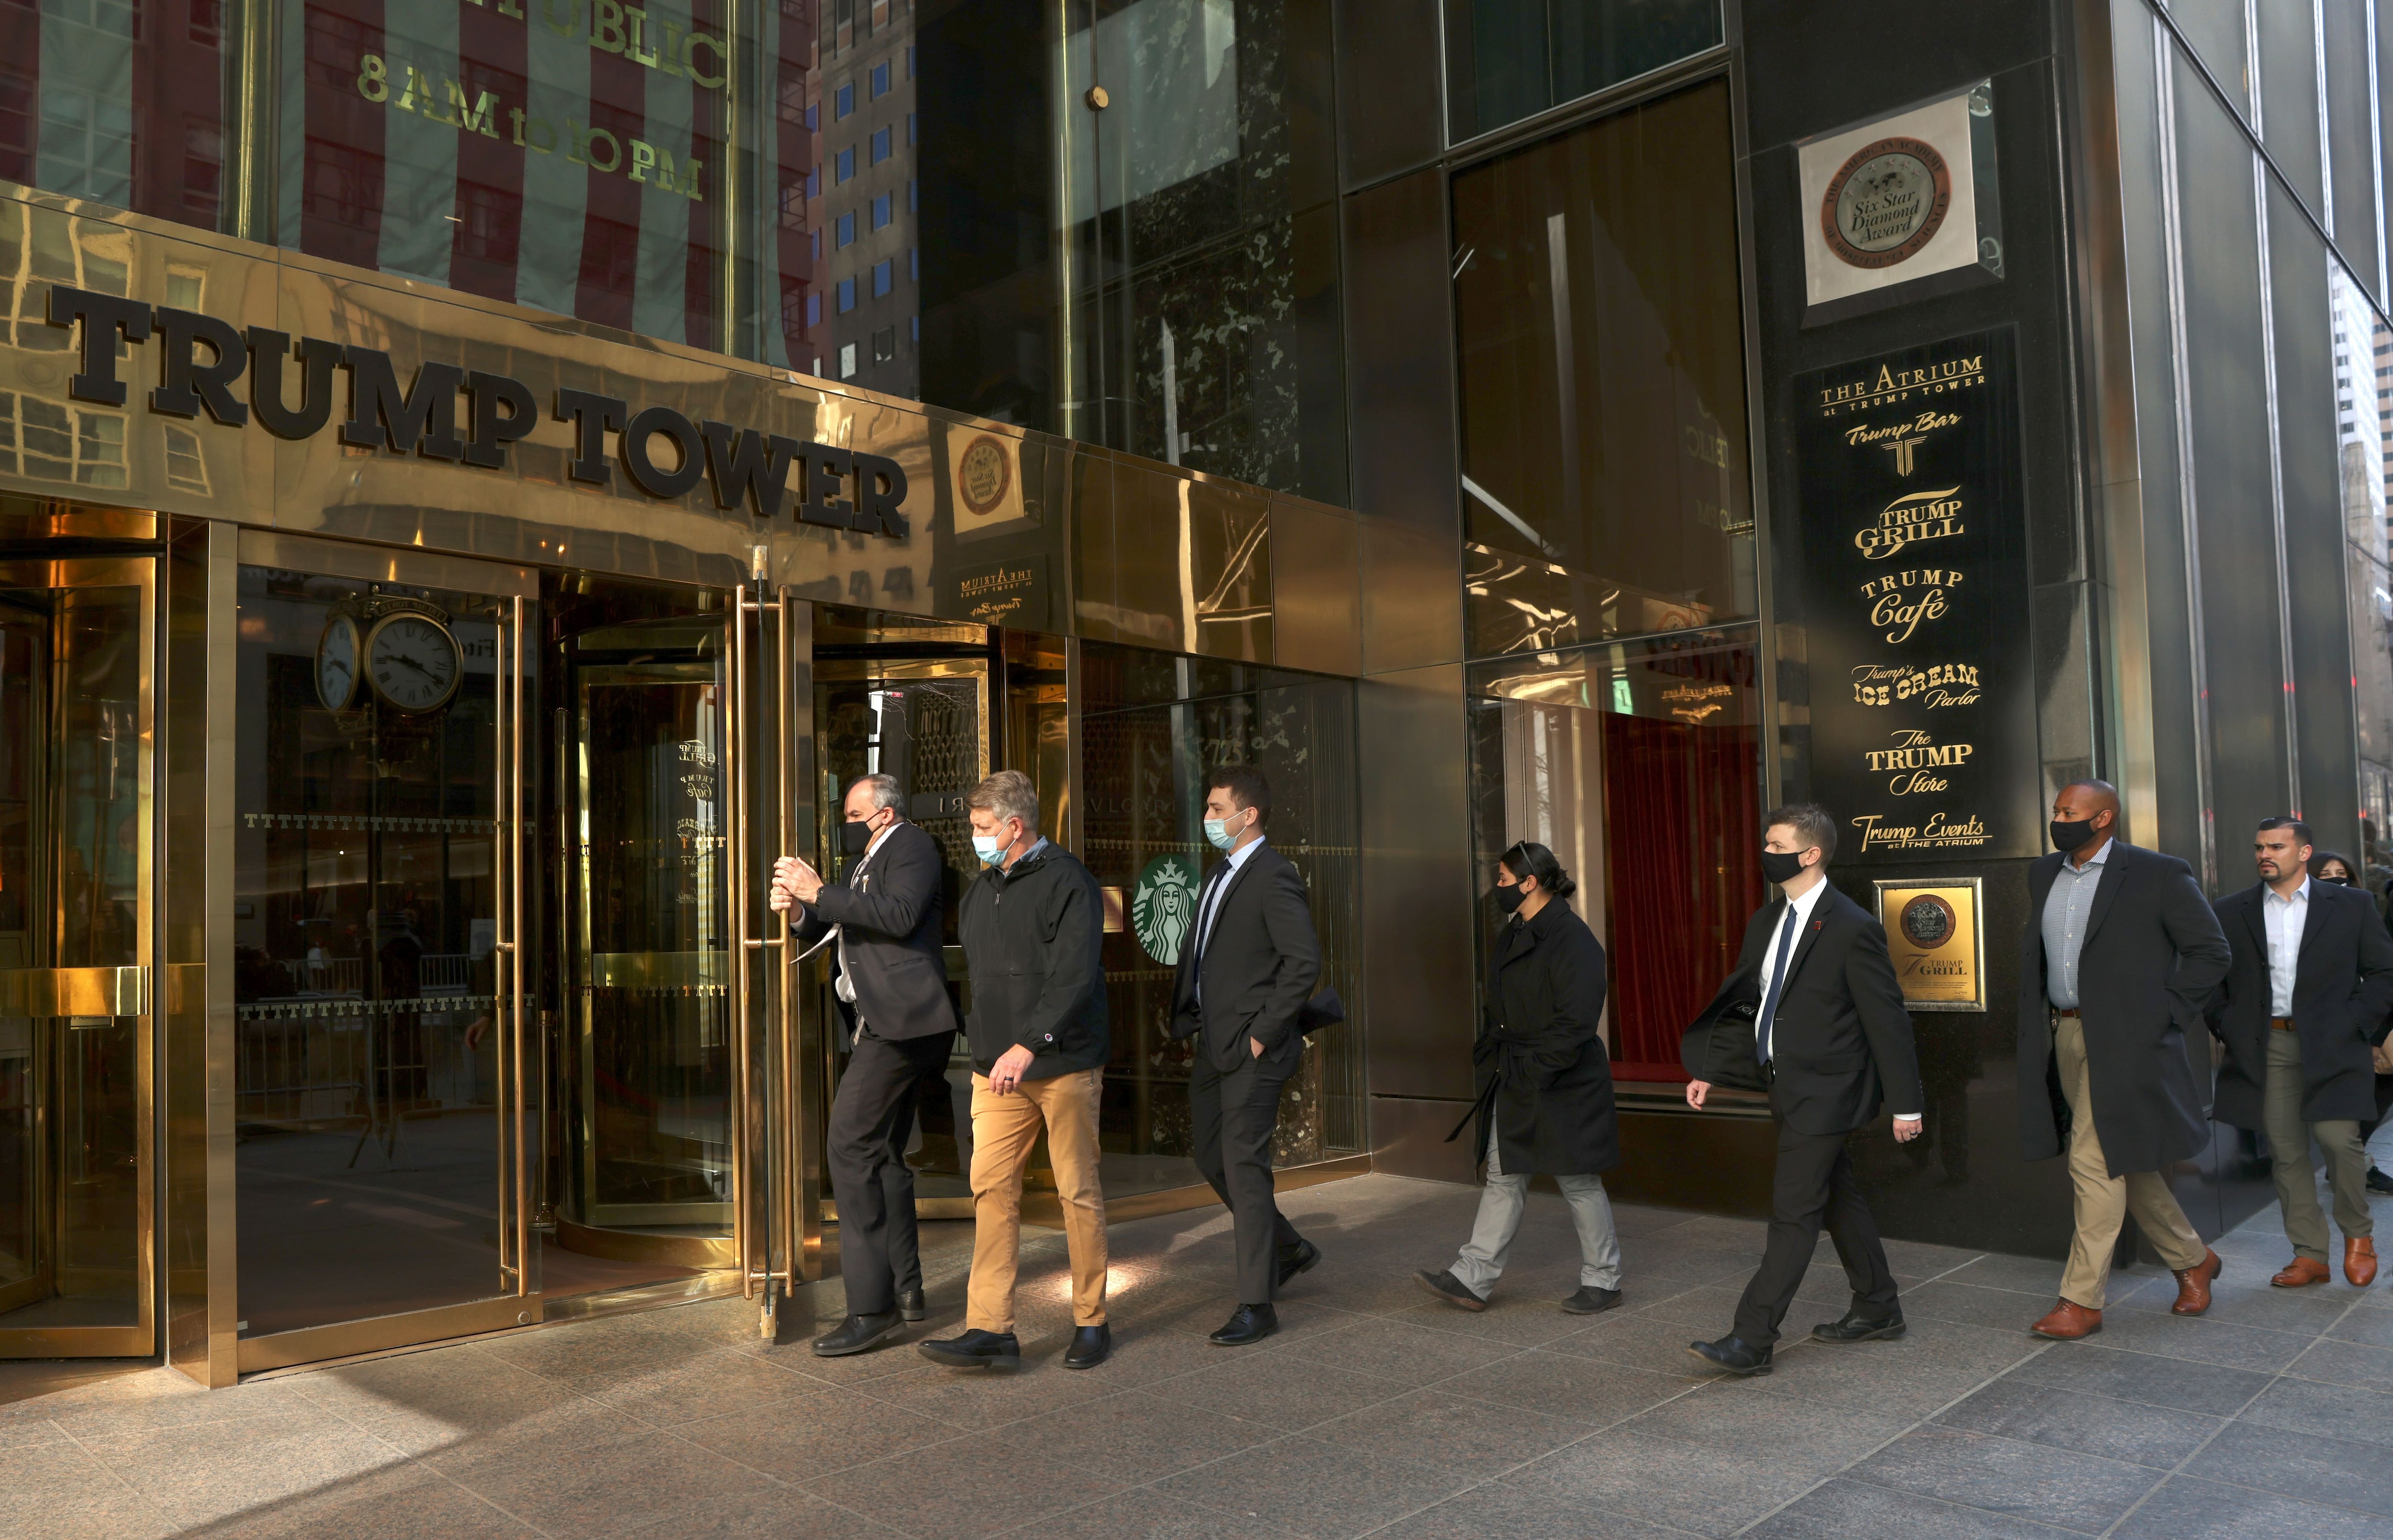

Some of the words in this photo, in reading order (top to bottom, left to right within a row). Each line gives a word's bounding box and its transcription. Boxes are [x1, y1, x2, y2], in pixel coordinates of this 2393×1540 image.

[358, 54, 389, 102] 8
[394, 66, 499, 139] AM
[509, 106, 558, 154] to
[628, 139, 703, 202] PM
[1851, 199, 1920, 232] Diamond
[1854, 201, 1879, 217] Six
[1883, 191, 1916, 209] Star
[1860, 216, 1912, 243] Award
[1821, 380, 1866, 403] THE
[1874, 355, 1984, 393] ATRIUM
[47, 284, 537, 469] TRUMP
[552, 388, 911, 538] TOWER
[1823, 408, 1836, 417] at
[1849, 391, 1909, 411] TRUMP
[1923, 375, 1985, 395] TOWER
[1845, 421, 1912, 446] Trump
[1914, 411, 1963, 433] Bar
[1879, 496, 1963, 526] TRUMP
[1855, 518, 1965, 555] GRILL
[1861, 569, 1964, 600] TRUMP
[1871, 588, 1950, 644] Café
[1851, 664, 1915, 683] Trump's
[1853, 683, 1891, 707] ICE
[1896, 662, 1980, 701] CREAM
[1924, 688, 1981, 710] Parlor
[1204, 738, 1242, 766] 725
[1890, 729, 1931, 748] The
[1866, 744, 1974, 771] TRUMP
[1889, 770, 1948, 796] Store
[1852, 814, 1917, 853] Trump
[1924, 813, 1984, 837] Events
[1935, 838, 1984, 847] ATRIUM
[1919, 966, 1968, 975] GRILL
